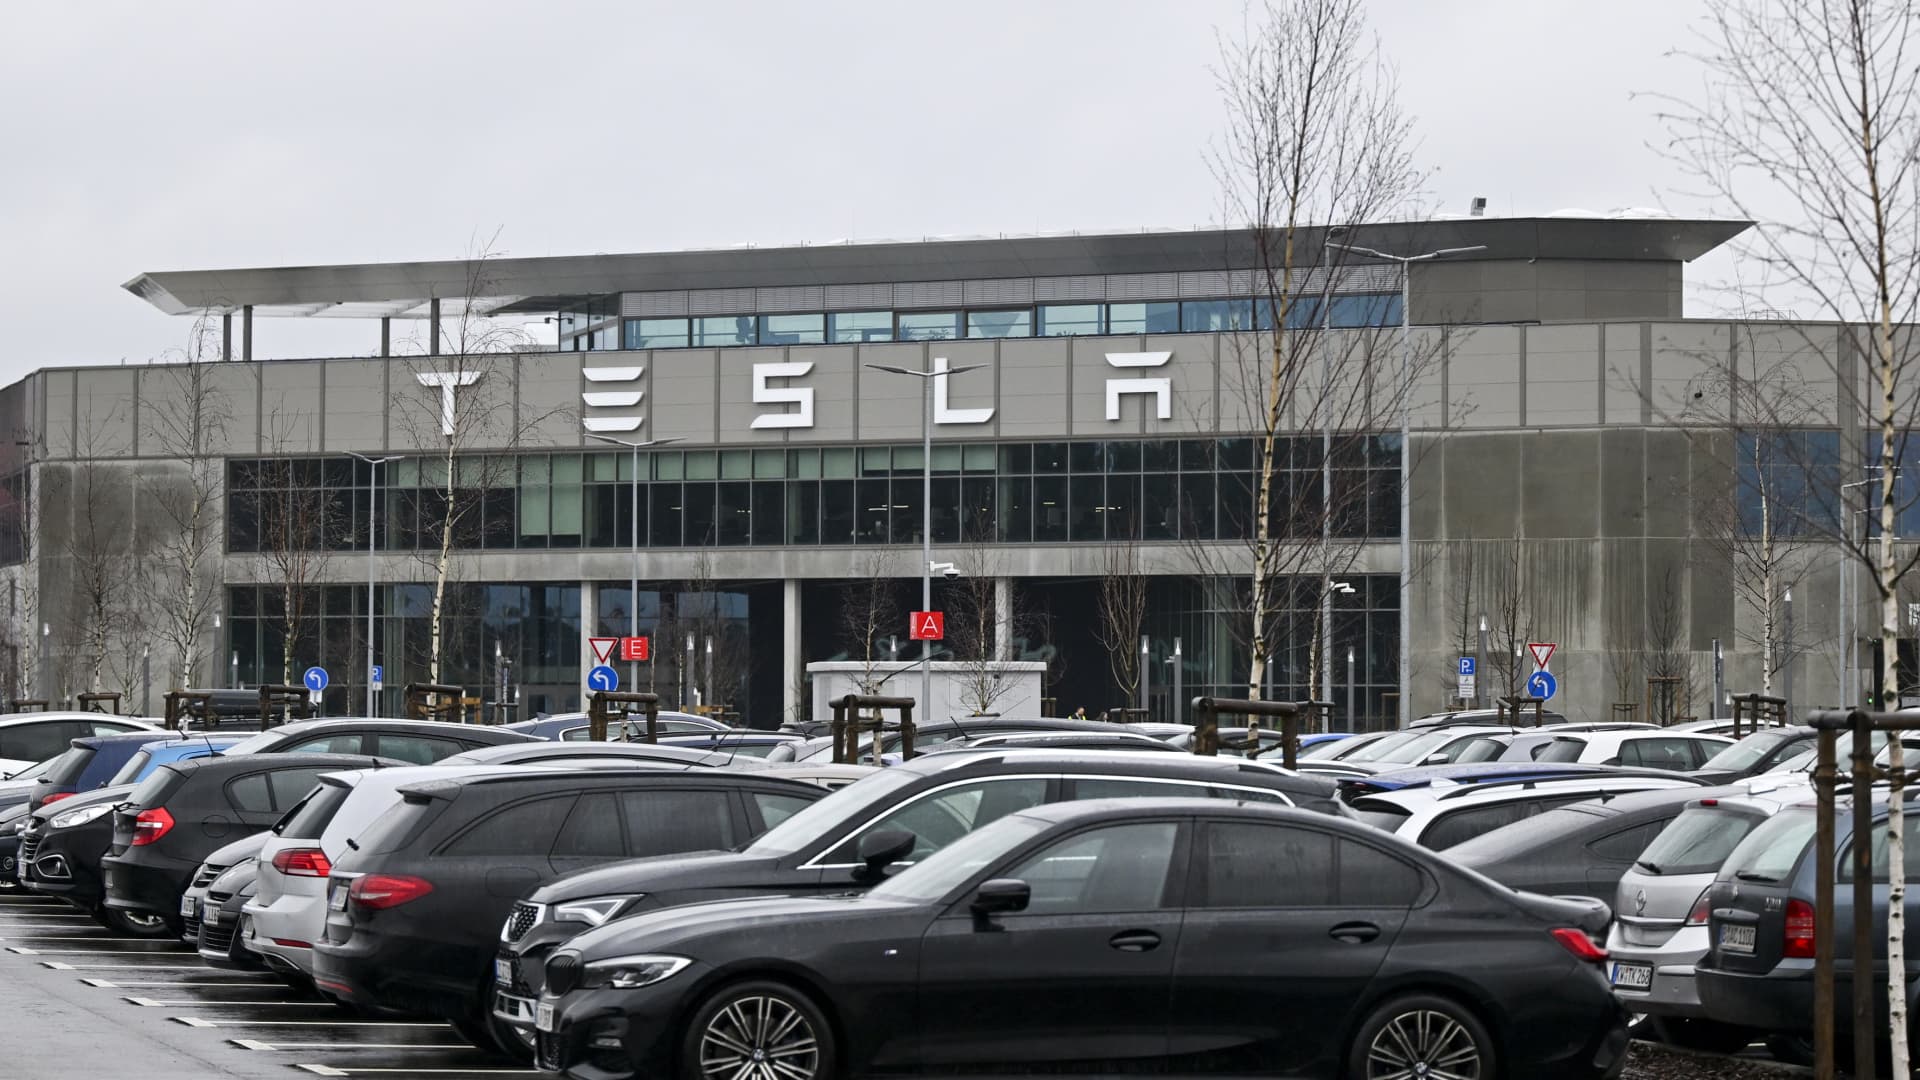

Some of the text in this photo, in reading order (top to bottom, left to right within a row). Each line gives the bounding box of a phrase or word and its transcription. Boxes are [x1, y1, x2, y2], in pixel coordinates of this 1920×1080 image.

[416, 352, 1173, 435] TESLA
[921, 615, 938, 633] A
[631, 640, 642, 656] E
[1461, 660, 1471, 673] P
[1637, 967, 1651, 985] 268
